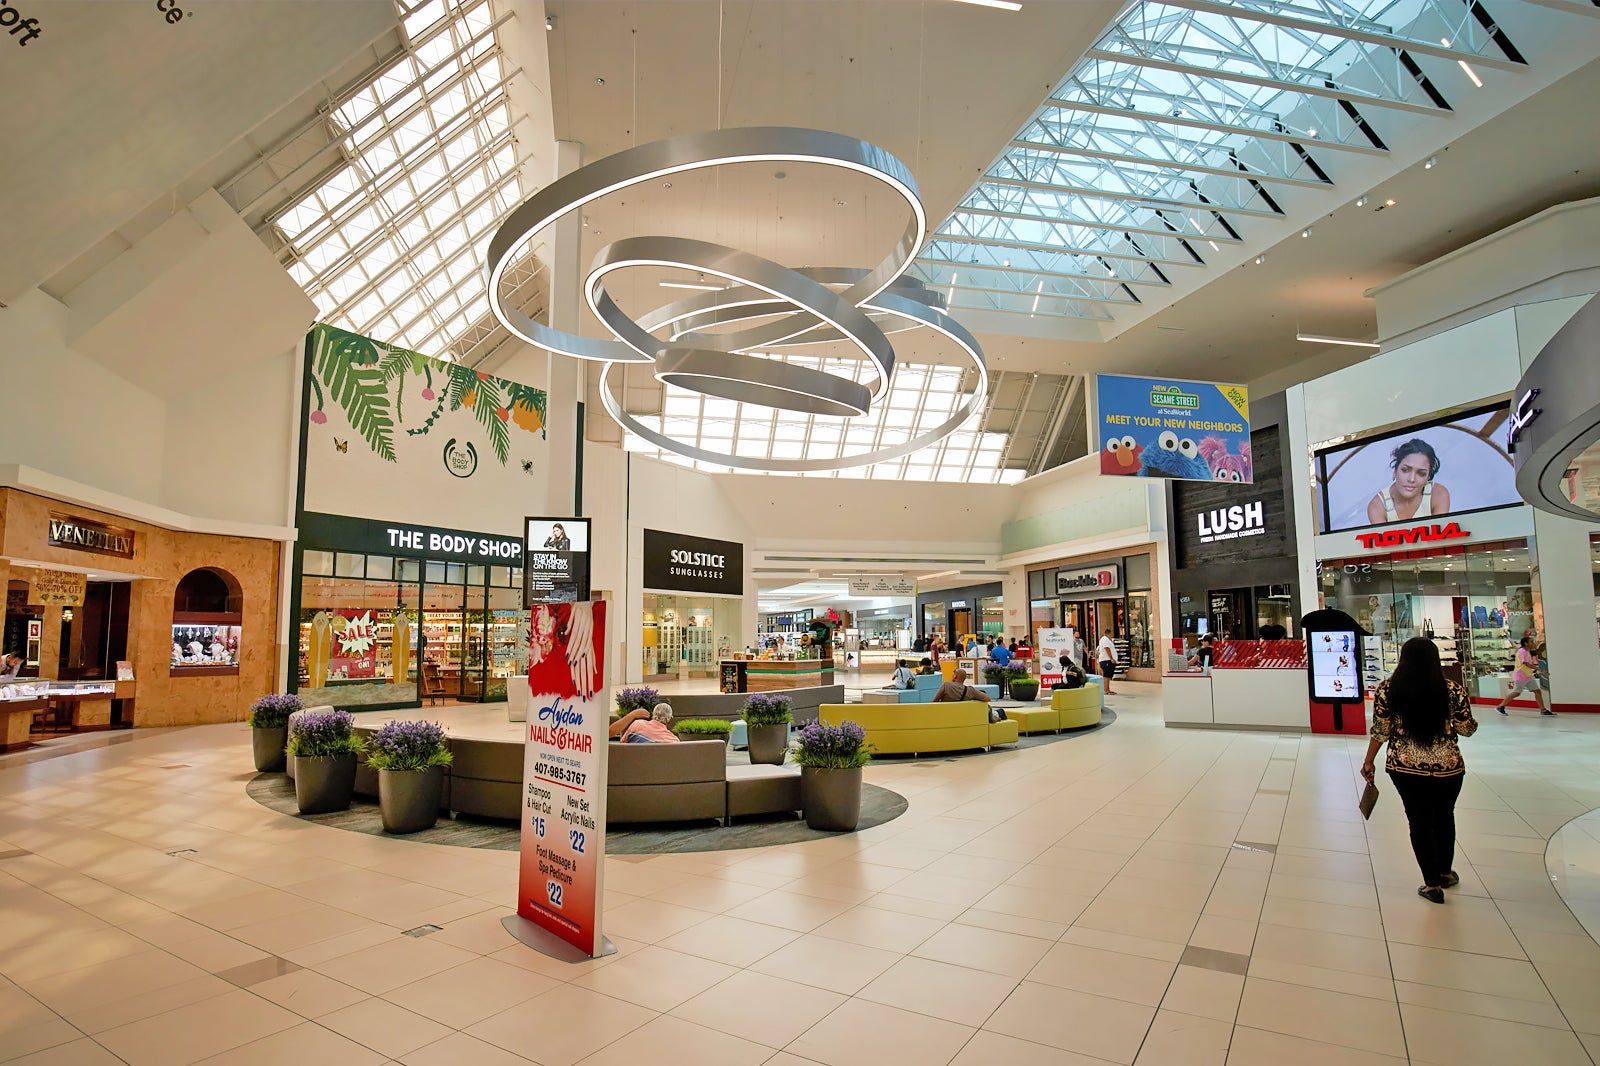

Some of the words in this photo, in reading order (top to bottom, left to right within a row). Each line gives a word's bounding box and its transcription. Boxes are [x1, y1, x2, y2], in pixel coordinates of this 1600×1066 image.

[0, 0, 42, 47] oft
[1152, 394, 1175, 405] SESAME
[1175, 396, 1197, 406] STREET
[1227, 391, 1243, 409] OPEN
[1230, 388, 1246, 404] NOW
[1163, 408, 1191, 417] SeaWorld
[1105, 414, 1132, 425] MEET
[1133, 416, 1161, 427] YOUR
[1163, 419, 1187, 430] NEW
[1188, 420, 1244, 433] NEIGHBORS
[452, 457, 469, 465] BODY
[454, 451, 467, 459] THE
[453, 462, 468, 470] SHOP
[1197, 501, 1264, 537] LUSH
[49, 519, 131, 554] VENETIAN
[1238, 527, 1266, 537] COSMETICS
[387, 528, 424, 549] THE
[429, 533, 476, 554] BODY
[478, 539, 522, 558] SHOP
[670, 549, 725, 568] SOLSTICE
[670, 566, 724, 579] SUNGLASSES
[68, 585, 82, 594] OFF
[340, 624, 373, 641] SALE
[534, 762, 586, 786] 407-985-3767
[528, 783, 551, 802] Shampoo
[527, 797, 531, 808] &
[531, 798, 542, 811] Hair
[542, 803, 551, 815] Cut
[567, 795, 579, 809] New
[579, 799, 590, 813] Set
[532, 816, 545, 838] $15
[561, 808, 580, 826] Acrylic
[580, 813, 595, 830] Nails
[569, 830, 585, 854] $22
[536, 844, 548, 859] Foot
[548, 848, 572, 870] Massage
[571, 859, 577, 872] &
[538, 861, 549, 875] Spa
[549, 865, 573, 885] Pedicure
[547, 882, 562, 906] $22
